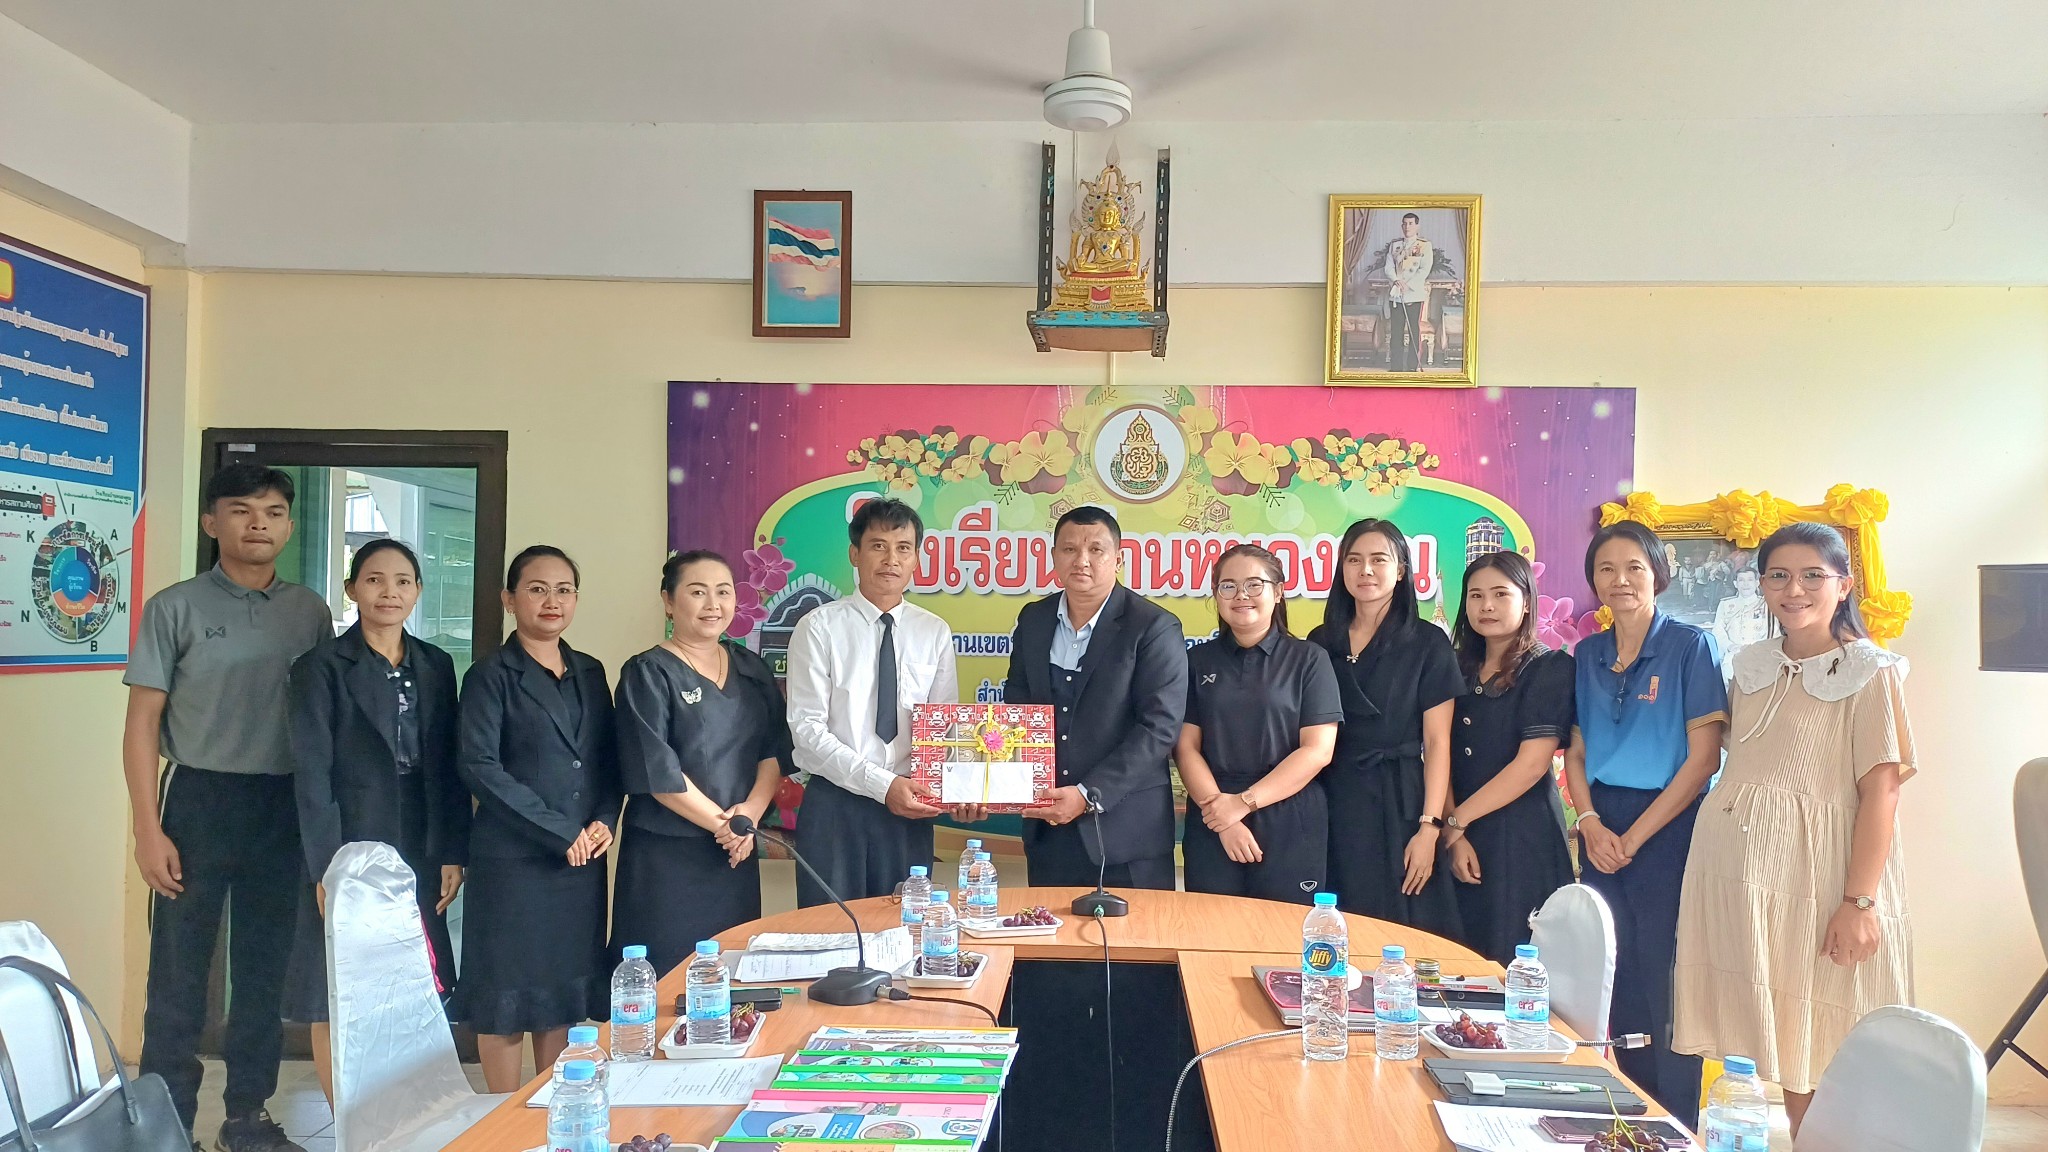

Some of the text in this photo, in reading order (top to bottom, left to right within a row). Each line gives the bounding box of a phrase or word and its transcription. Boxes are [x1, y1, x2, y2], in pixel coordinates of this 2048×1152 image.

[26, 529, 36, 543] K
[110, 528, 119, 541] A
[117, 601, 126, 614] M
[20, 609, 30, 623] N
[90, 640, 98, 652] B
[1309, 949, 1332, 966] Jiffy
[623, 1003, 639, 1013] era
[1376, 999, 1389, 1011] era
[1518, 1000, 1534, 1011] era
